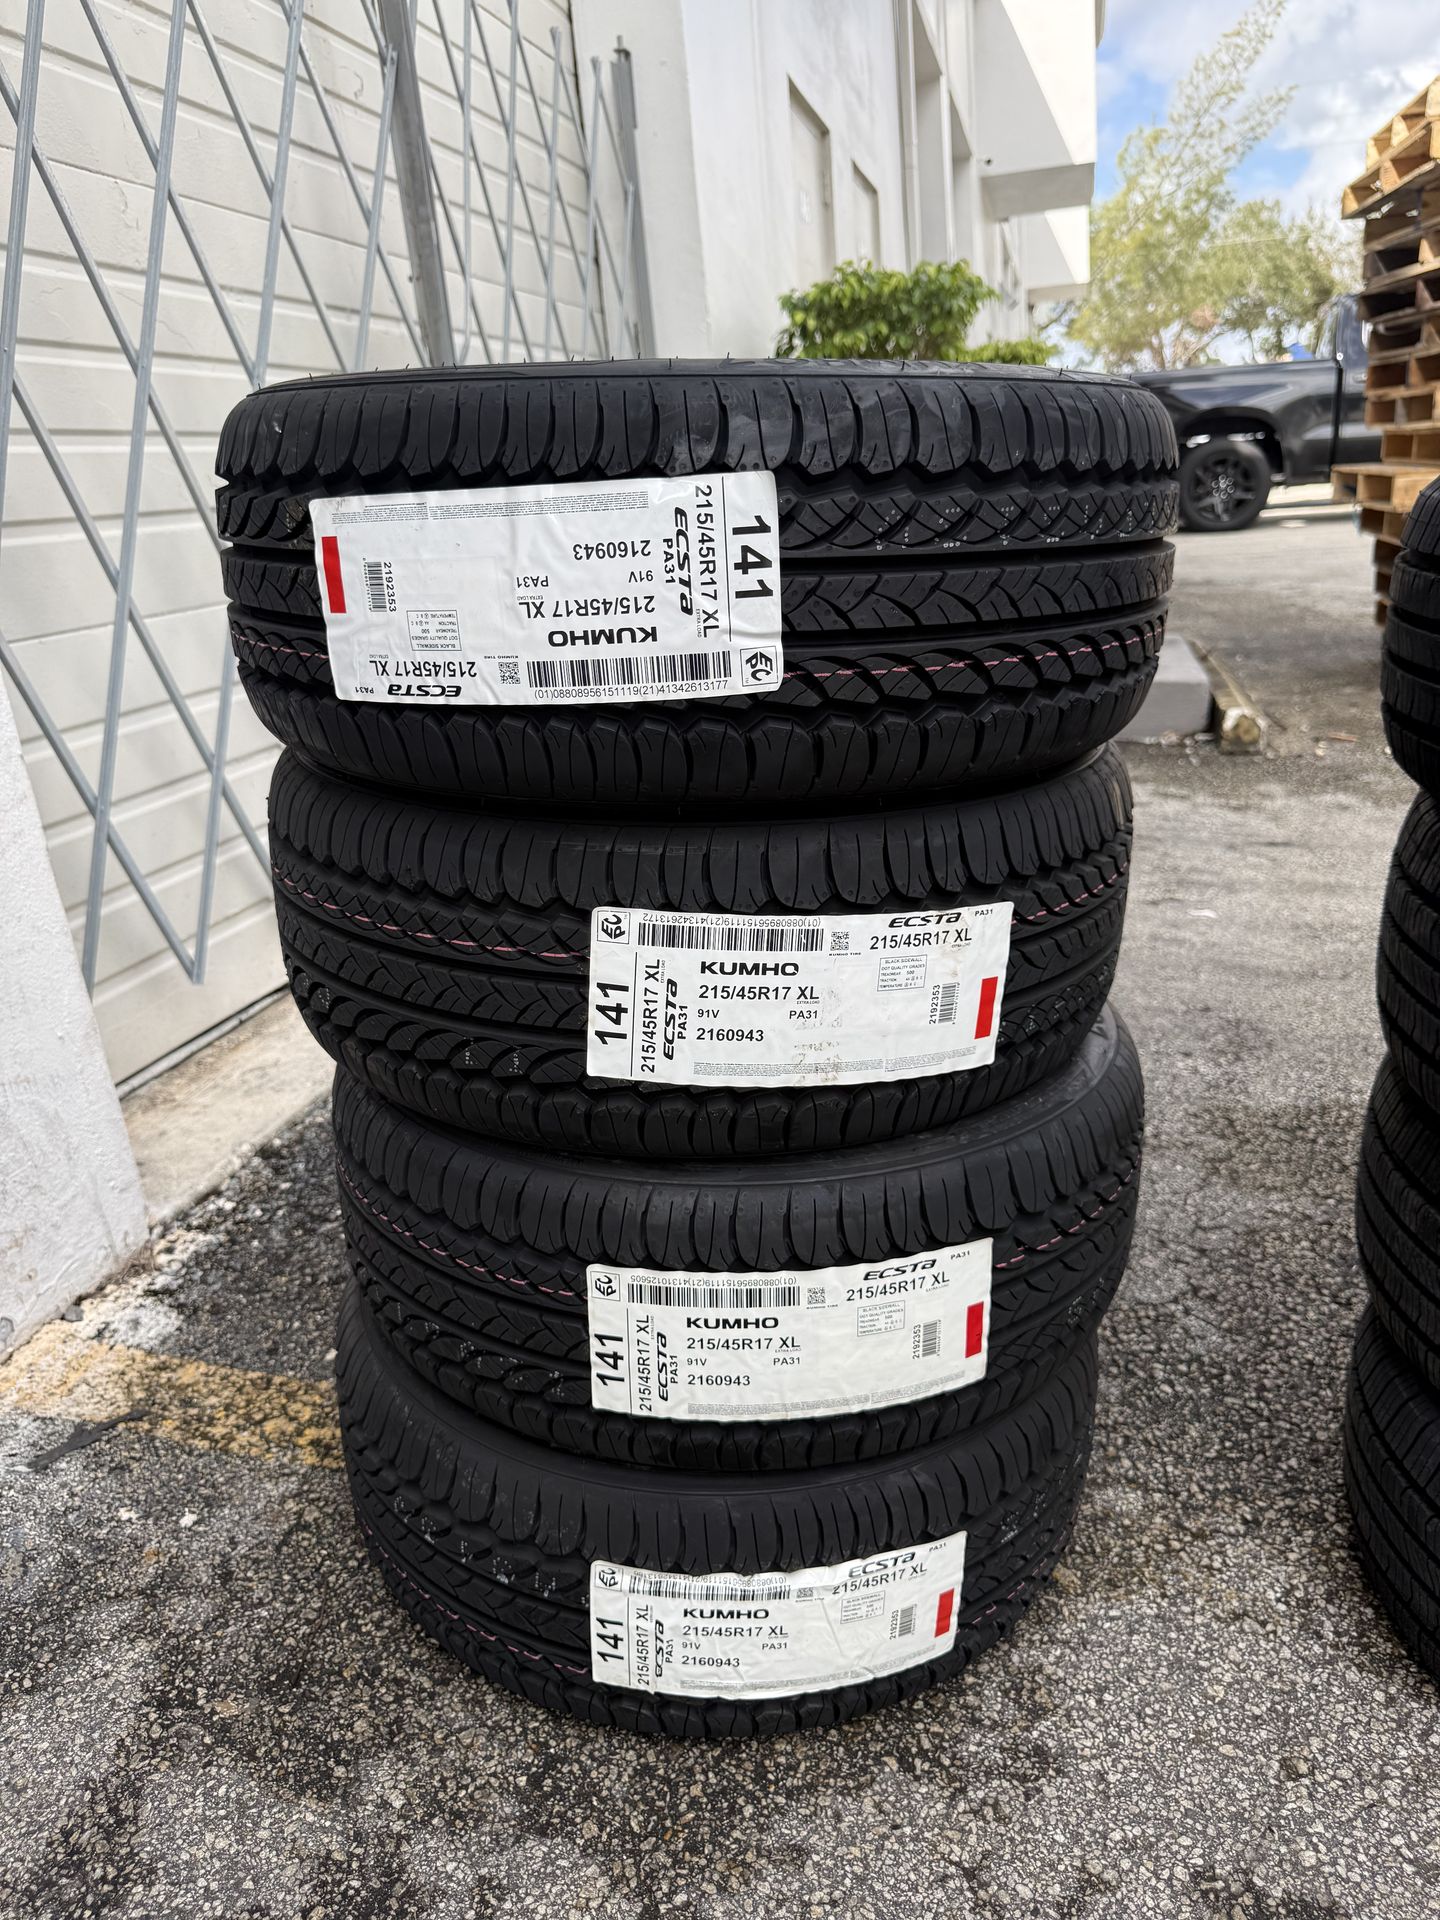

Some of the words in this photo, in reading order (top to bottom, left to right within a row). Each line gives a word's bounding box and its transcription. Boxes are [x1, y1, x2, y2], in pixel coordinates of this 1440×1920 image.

[573, 539, 651, 559] 2160943
[695, 484, 716, 602] 215/45R17
[662, 538, 675, 584] PA31
[730, 515, 772, 600] 141
[515, 575, 549, 588] PA31
[628, 569, 653, 582] 91V
[384, 562, 397, 612] 2192353
[518, 600, 544, 619] XL
[552, 595, 655, 618] 215/45R17
[702, 609, 720, 638] XL
[548, 626, 657, 647] KUMHO
[369, 660, 389, 677] XL
[393, 659, 477, 678] 215/45R17
[355, 686, 374, 694] PA31
[870, 931, 950, 950] 215/45R17
[954, 928, 972, 942] XL
[643, 959, 660, 984] XL
[699, 985, 791, 1000] 215/45R17
[797, 986, 819, 1000] XL
[594, 981, 629, 1045] 141
[698, 1009, 719, 1019] 91V
[789, 1010, 818, 1019] PA31
[929, 984, 940, 1024] 2192353
[641, 989, 658, 1073] 215/45R17
[678, 1005, 687, 1039] PA31
[696, 1028, 764, 1042] 2160943
[951, 1250, 970, 1260] PA31
[846, 1277, 926, 1301] 215/45R17
[932, 1271, 950, 1286] XL
[636, 1315, 650, 1333] XL
[687, 1317, 779, 1330] KUMHO
[687, 1337, 774, 1351] 215/45R17
[779, 1337, 800, 1349] XL
[913, 1324, 921, 1359] 2192353
[596, 1333, 625, 1387] 141
[670, 1354, 678, 1384] PA31
[687, 1358, 707, 1366] 91V
[773, 1356, 800, 1365] PA31
[637, 1339, 654, 1412] 215/45R17
[687, 1374, 750, 1386] 2160943
[929, 1543, 947, 1552] PA31
[832, 1569, 905, 1595] 215/45R17
[910, 1563, 927, 1576] XL
[637, 1604, 649, 1620] XL
[683, 1608, 770, 1620] KUMHO
[596, 1616, 624, 1663] 141
[683, 1625, 762, 1638] 215/45R17
[768, 1625, 788, 1636] XL
[637, 1624, 650, 1686] 215/45R17
[665, 1639, 673, 1664] PA31
[682, 1642, 701, 1650] 91V
[762, 1641, 788, 1650] PA31
[682, 1656, 740, 1668] 2160943
